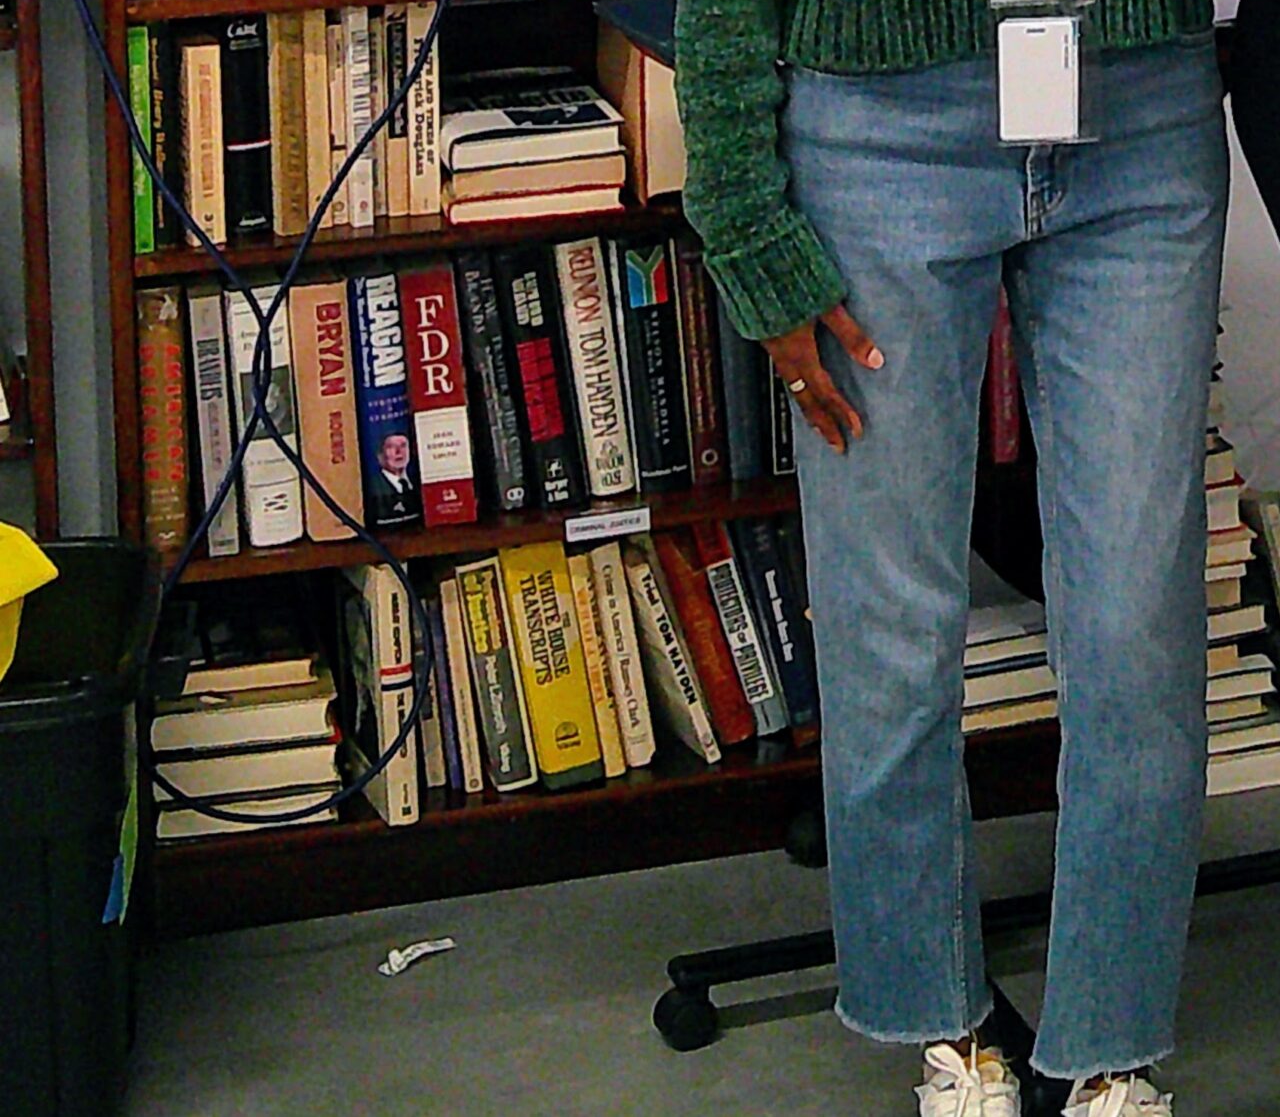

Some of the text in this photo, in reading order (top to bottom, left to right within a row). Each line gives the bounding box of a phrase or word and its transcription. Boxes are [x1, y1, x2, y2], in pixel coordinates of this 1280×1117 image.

[413, 113, 424, 176] Douglass
[426, 108, 434, 145] TIMES
[427, 149, 434, 165] OF
[365, 275, 406, 387] REAGAN
[415, 294, 454, 396] FDR
[568, 247, 619, 438] REUNION TOM HAYDEN
[316, 303, 346, 464] BRYAN KOENIG
[657, 377, 671, 445] MANDELA
[467, 594, 490, 654] Justice
[485, 656, 499, 685] Peter
[519, 575, 553, 686] TRANSCRIPTS
[537, 571, 570, 678] WHITE HOUSE
[610, 611, 624, 652] America
[627, 698, 640, 728] Clark
[656, 614, 674, 646] TOM
[668, 648, 697, 705] HAYDEN
[710, 563, 770, 702] PROTECTORS OF PRIVILEGE
